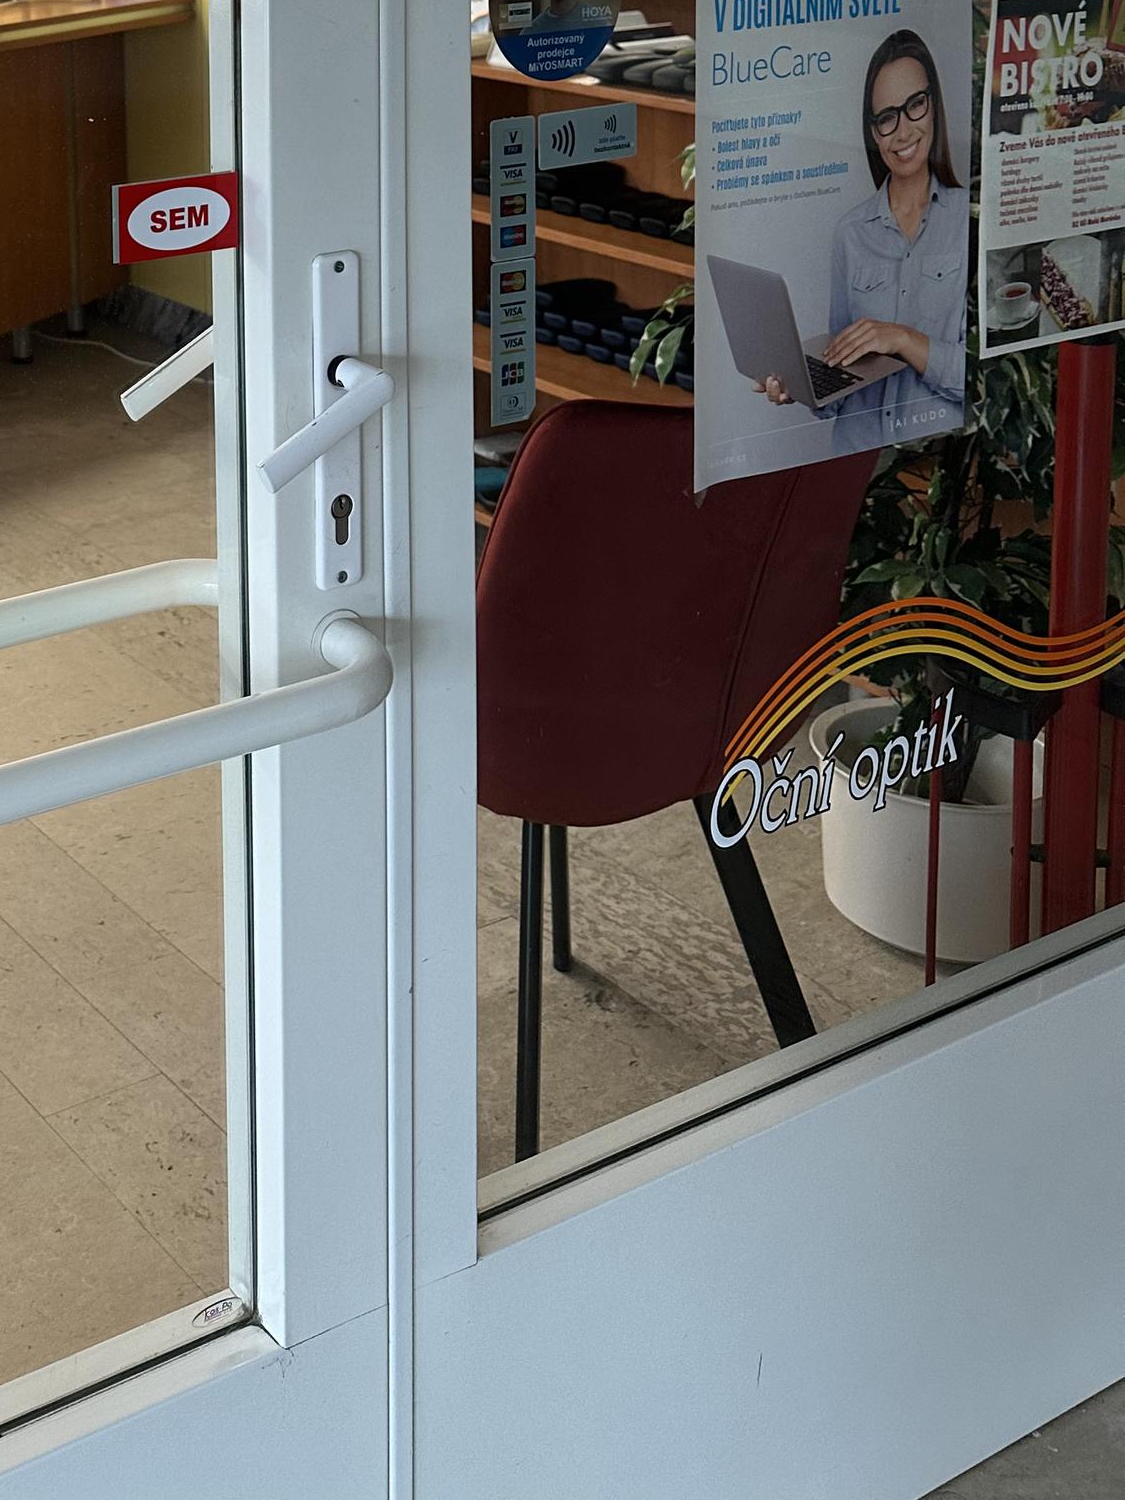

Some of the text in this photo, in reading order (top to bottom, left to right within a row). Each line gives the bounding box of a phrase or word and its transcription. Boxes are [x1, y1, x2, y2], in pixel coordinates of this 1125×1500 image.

[581, 5, 613, 18] HOYA
[1002, 0, 1088, 54] NOVÉ
[527, 34, 585, 48] Autorizovaný
[537, 47, 575, 61] prodejce
[712, 45, 832, 87] BlueCare
[999, 50, 1104, 98] BISTRO
[750, 116, 766, 129] tyto
[767, 110, 803, 128] příznaky?
[508, 130, 519, 144] V
[717, 140, 740, 154] Bolest
[741, 136, 762, 153] hlavy
[999, 140, 1028, 153] Zveme
[1029, 136, 1044, 149] Vás
[1045, 134, 1056, 147] do
[717, 155, 768, 173] Celková únava
[503, 168, 524, 180] VISA
[716, 175, 749, 192] Problémy
[750, 175, 760, 186] se
[761, 170, 795, 187] spánkem
[149, 203, 210, 234] SEM
[503, 306, 523, 318] VISA
[504, 337, 524, 350] VISA
[503, 368, 524, 381] JCB
[889, 407, 948, 433] JAI KUDO
[709, 686, 964, 850] Oční optik
